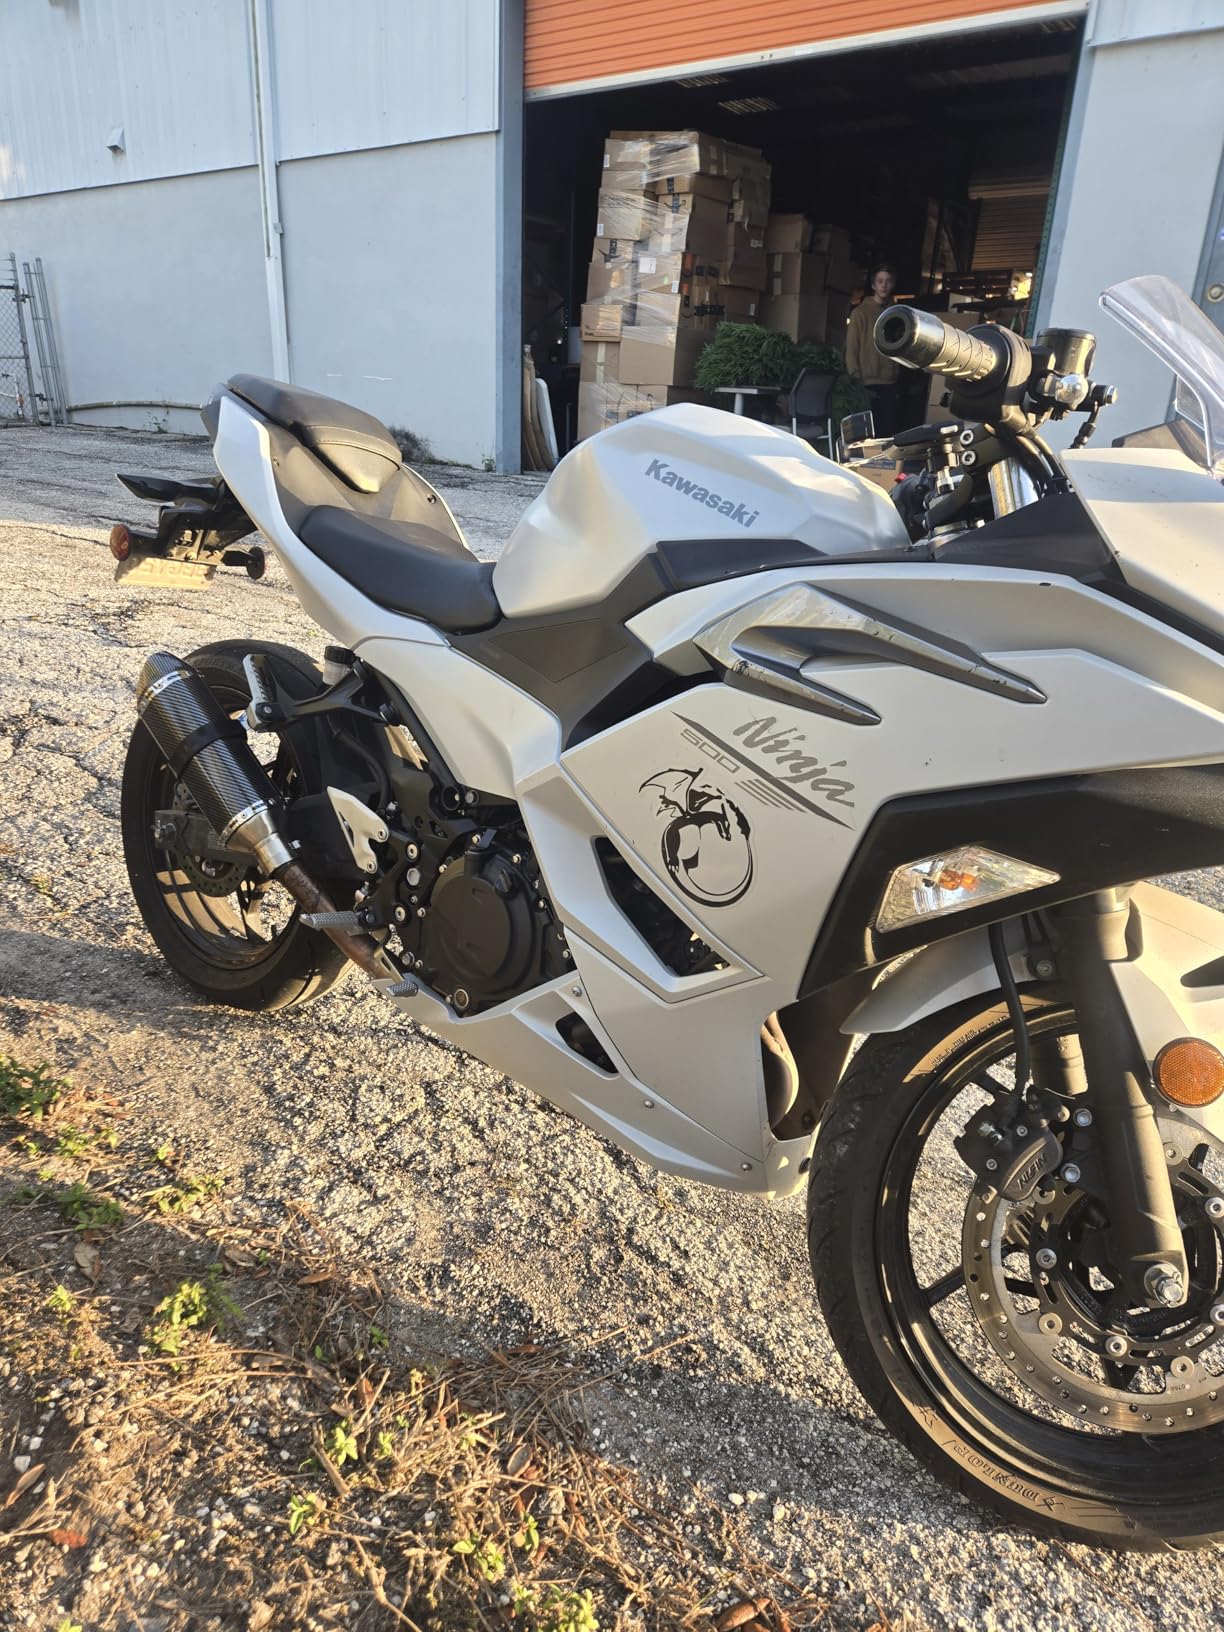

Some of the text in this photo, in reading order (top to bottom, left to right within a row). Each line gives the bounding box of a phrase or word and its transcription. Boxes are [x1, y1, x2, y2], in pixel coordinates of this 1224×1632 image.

[645, 459, 760, 528] Kawasaki
[680, 728, 741, 774] 500
[732, 716, 855, 808] Ninja
[953, 1445, 1040, 1503] DUNLOP
